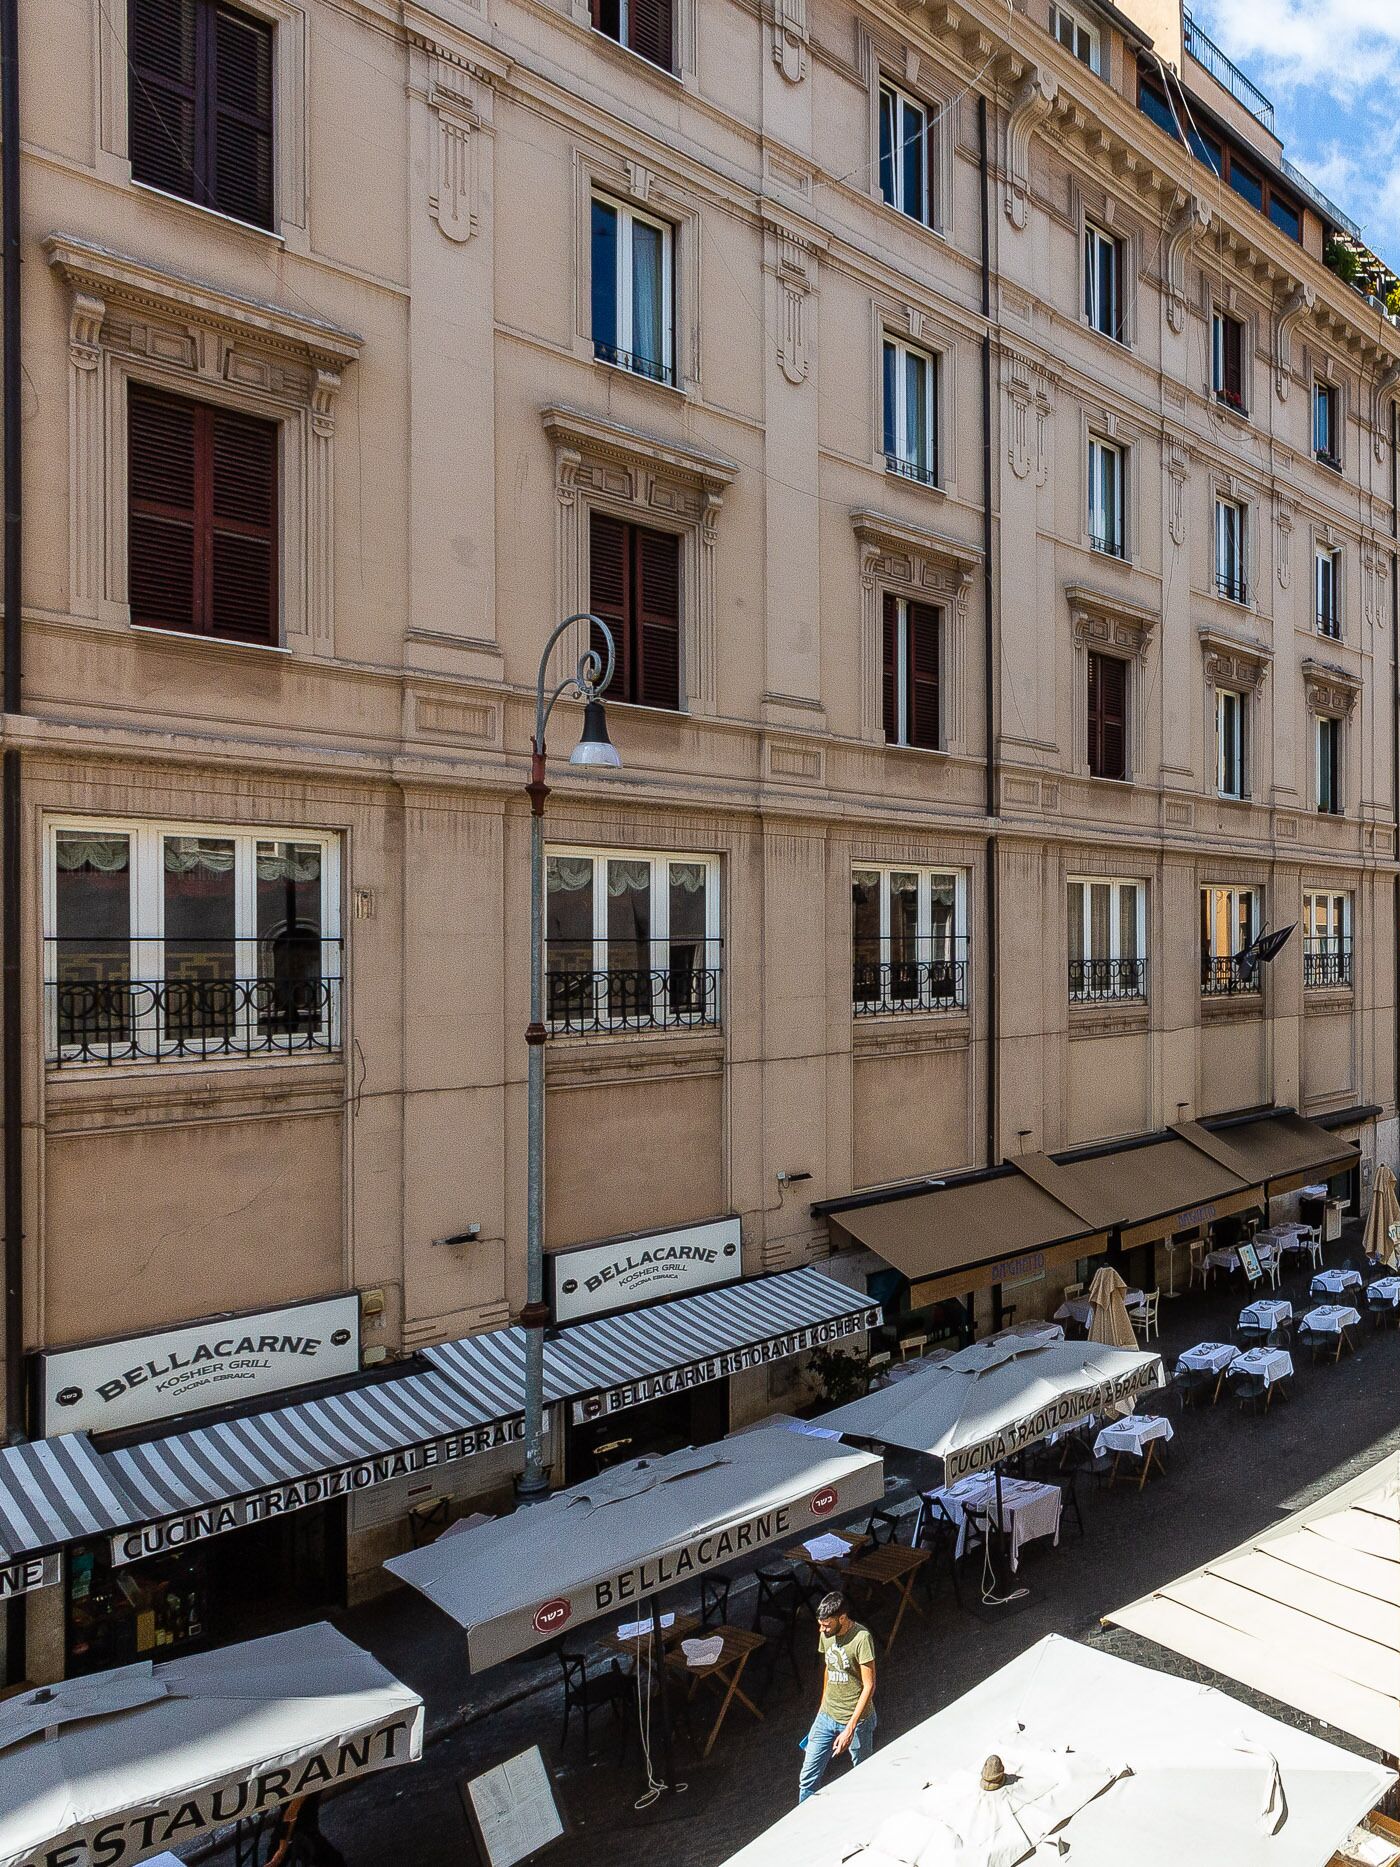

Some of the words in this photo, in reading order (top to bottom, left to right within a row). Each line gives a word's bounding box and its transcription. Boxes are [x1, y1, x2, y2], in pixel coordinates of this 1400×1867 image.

[584, 1246, 718, 1293] BELLACARNE
[618, 1266, 659, 1287] KOSHER
[661, 1264, 688, 1272] GRILL
[95, 1335, 322, 1403] BELLACARNE
[155, 1362, 224, 1393] KOSHER
[228, 1359, 272, 1370] GRILL
[172, 1377, 211, 1396] CUCINA
[213, 1372, 256, 1383] EBRAICA
[609, 1363, 716, 1411] BELLACARNE
[719, 1335, 808, 1374] RISTORANTE
[811, 1317, 861, 1345] KOSHER
[950, 1432, 1005, 1478] CUCINA
[1105, 1366, 1159, 1404] EBRAICA
[122, 1508, 237, 1559] CUCINA
[246, 1447, 439, 1521] TRADIZIONALE
[445, 1419, 526, 1460] EBRAIC
[815, 1495, 833, 1508] כשר
[595, 1507, 791, 1611] BELLACARNE
[540, 1608, 564, 1624] כשר
[22, 1721, 407, 1867] ESTAURANT
